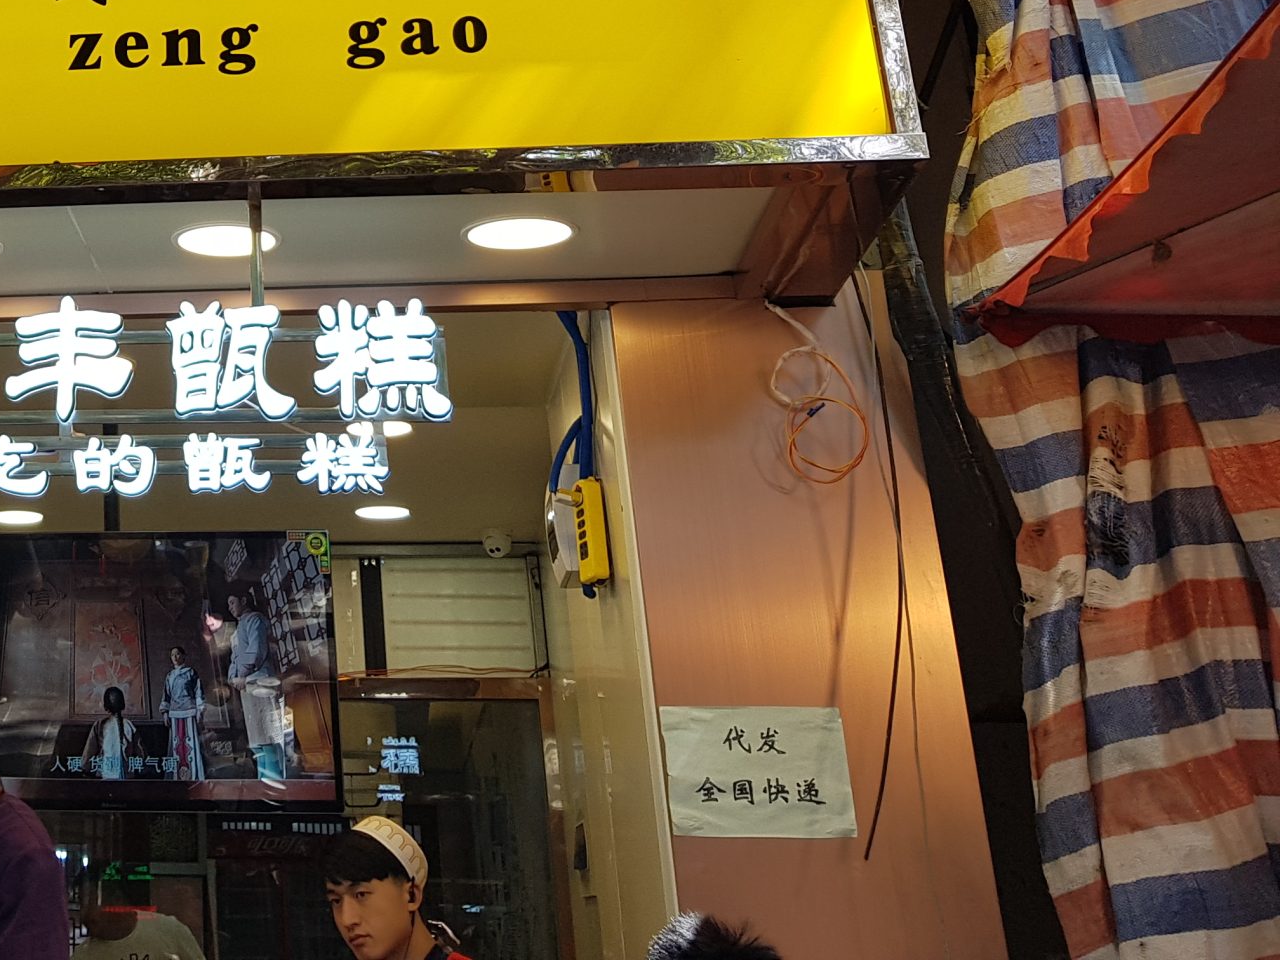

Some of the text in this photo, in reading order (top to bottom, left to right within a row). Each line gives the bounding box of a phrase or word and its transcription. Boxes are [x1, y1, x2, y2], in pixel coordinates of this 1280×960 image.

[68, 14, 488, 75] zeng gao
[723, 726, 786, 754] 代发
[50, 755, 83, 773] 人硬
[127, 755, 179, 774] 脾气硬
[695, 777, 826, 805] 全国快递
